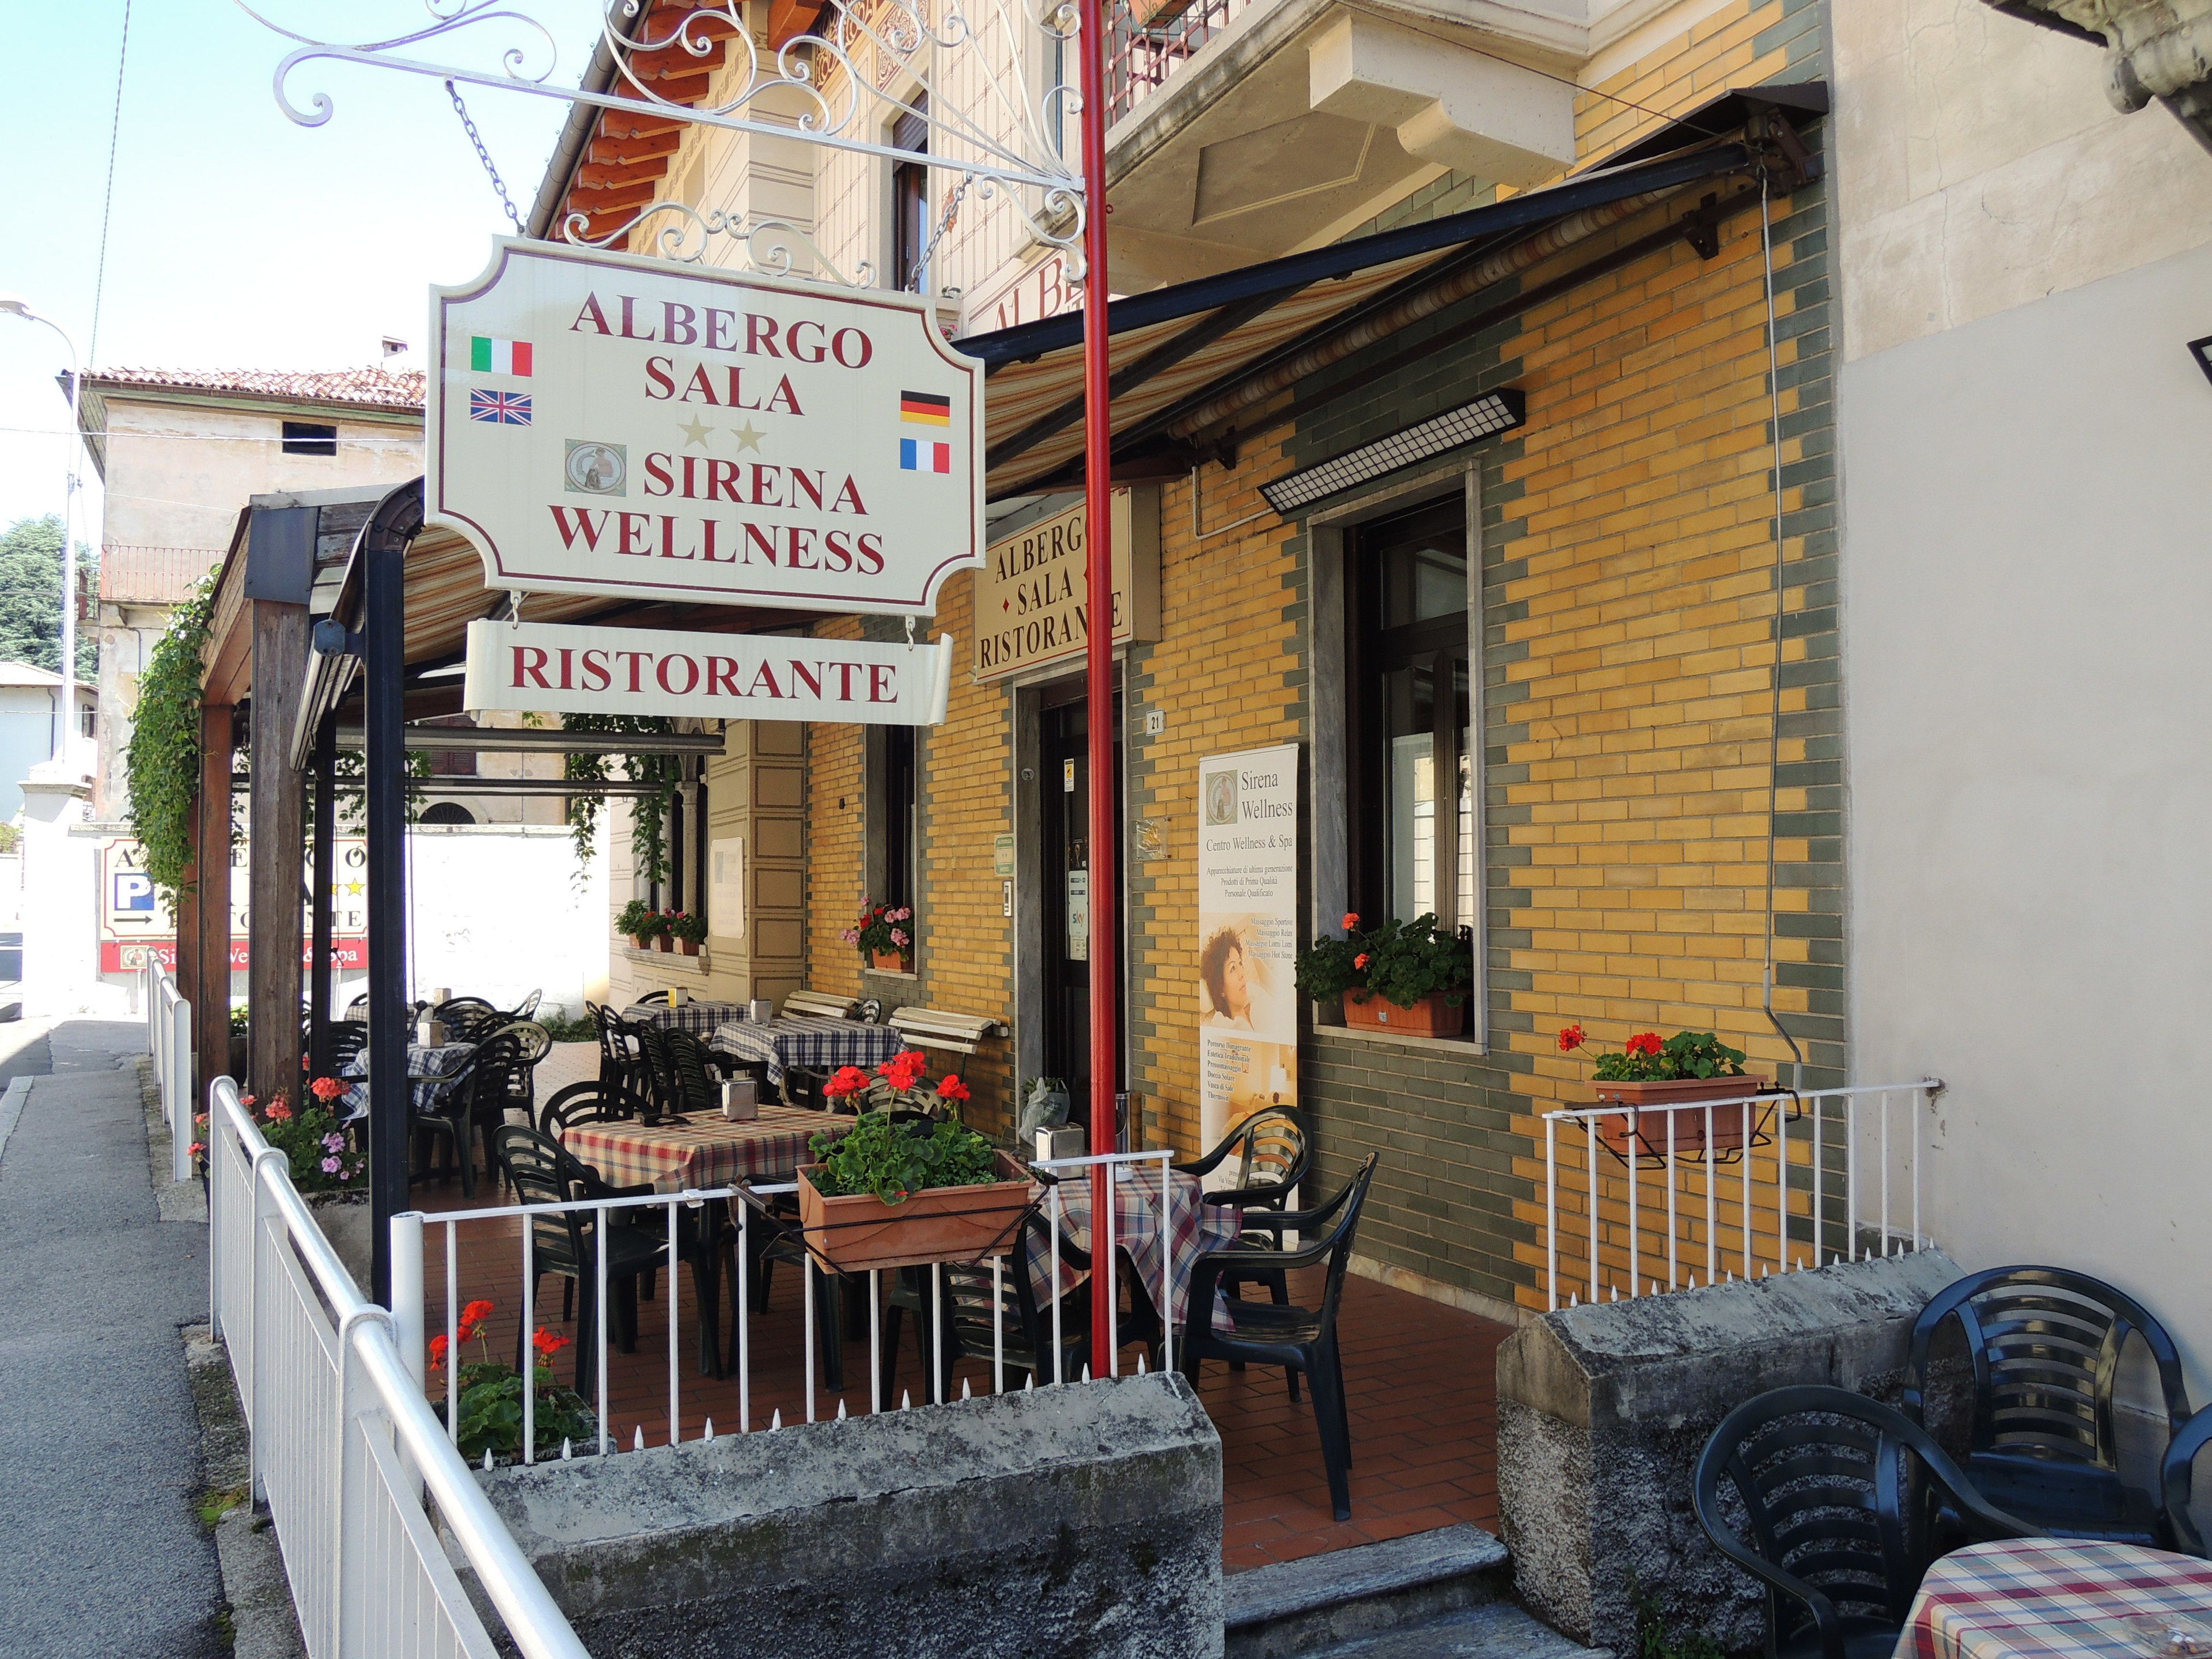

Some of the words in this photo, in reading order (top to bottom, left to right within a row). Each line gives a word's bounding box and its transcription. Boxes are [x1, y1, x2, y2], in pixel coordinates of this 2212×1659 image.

[570, 291, 872, 369] ALBERGO
[645, 356, 805, 416] SALA
[643, 452, 869, 516] SIRENA
[547, 505, 884, 574] WELLNESS
[995, 516, 1087, 584] ALBERG
[1017, 566, 1073, 616] SALA
[980, 591, 1122, 669] RISTORANE
[508, 646, 899, 704] RISTORANTE
[1152, 716, 1158, 729] 21
[1242, 771, 1278, 790] Sirena
[1242, 799, 1293, 820] Wellness
[1207, 839, 1230, 851] Centro
[1233, 836, 1266, 850] Wellness
[1268, 835, 1275, 848] &
[1279, 834, 1292, 851] Spa
[1207, 866, 1242, 876] Apparecchiature
[1249, 865, 1263, 874] ultima
[1264, 864, 1293, 874] generazione
[1221, 878, 1238, 886] Prodotti
[1240, 877, 1244, 885] di
[1245, 877, 1259, 885] Prima
[1260, 876, 1278, 886] Qualità
[118, 876, 151, 908] P
[1247, 889, 1273, 898] Qualificato
[1073, 910, 1084, 927] sky
[1251, 918, 1274, 927] Massaggio
[1275, 918, 1293, 927] Sportivo
[1257, 929, 1280, 938] Massaggio
[1246, 939, 1267, 948] Massaggio
[1248, 950, 1270, 960] Massaggio
[1207, 1039, 1225, 1048] Percorso
[1207, 1050, 1223, 1058] Estetica
[1225, 1052, 1250, 1063] Tradizionale
[1207, 1060, 1241, 1073] Pressomassaggio
[1207, 1070, 1221, 1079] Doccia
[1222, 1073, 1235, 1081] Solare
[1207, 1081, 1219, 1089] Vasca
